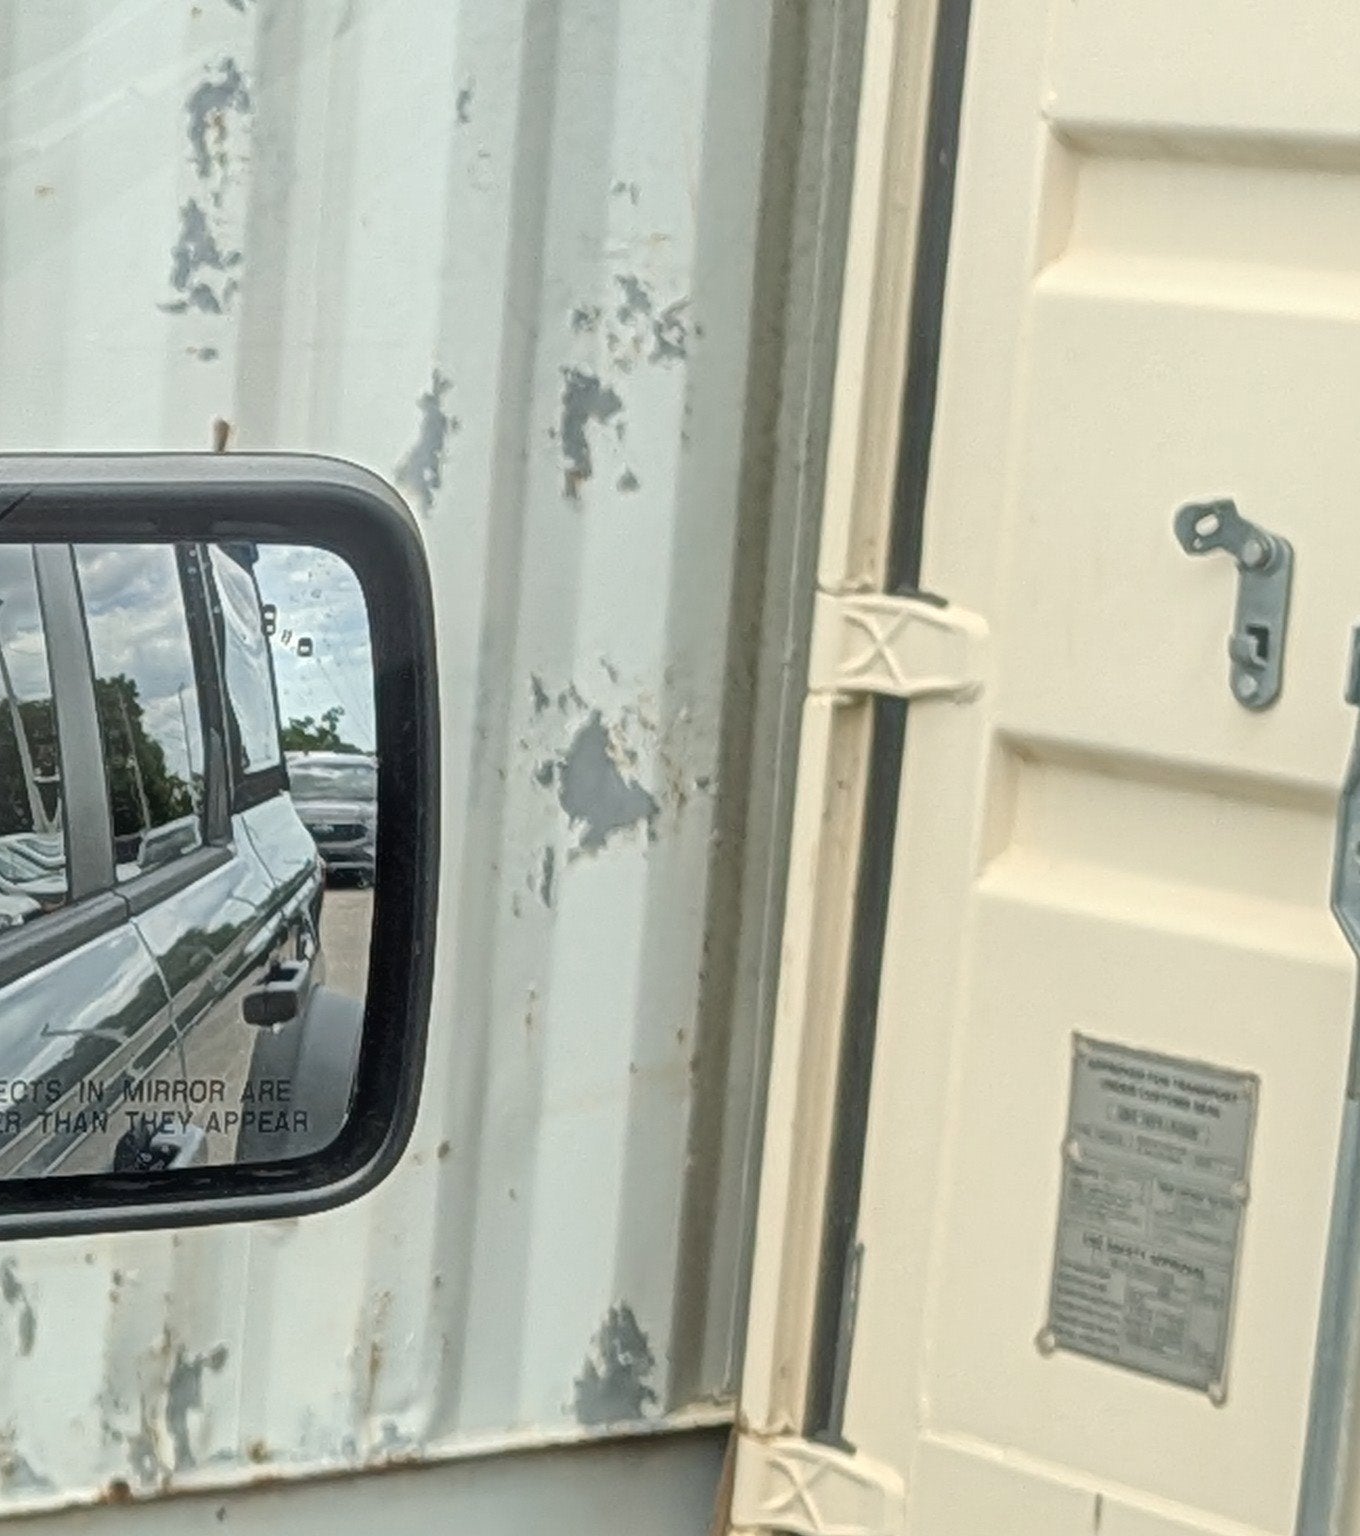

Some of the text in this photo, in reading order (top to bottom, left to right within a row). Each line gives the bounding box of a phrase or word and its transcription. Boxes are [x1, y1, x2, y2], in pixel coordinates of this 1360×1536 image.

[81, 1080, 105, 1103] IN
[123, 1079, 226, 1103] MIRROR
[242, 1079, 292, 1102] ARE
[37, 1110, 108, 1133] THAN
[125, 1110, 193, 1134] THEY
[205, 1110, 309, 1133] APPEAR
